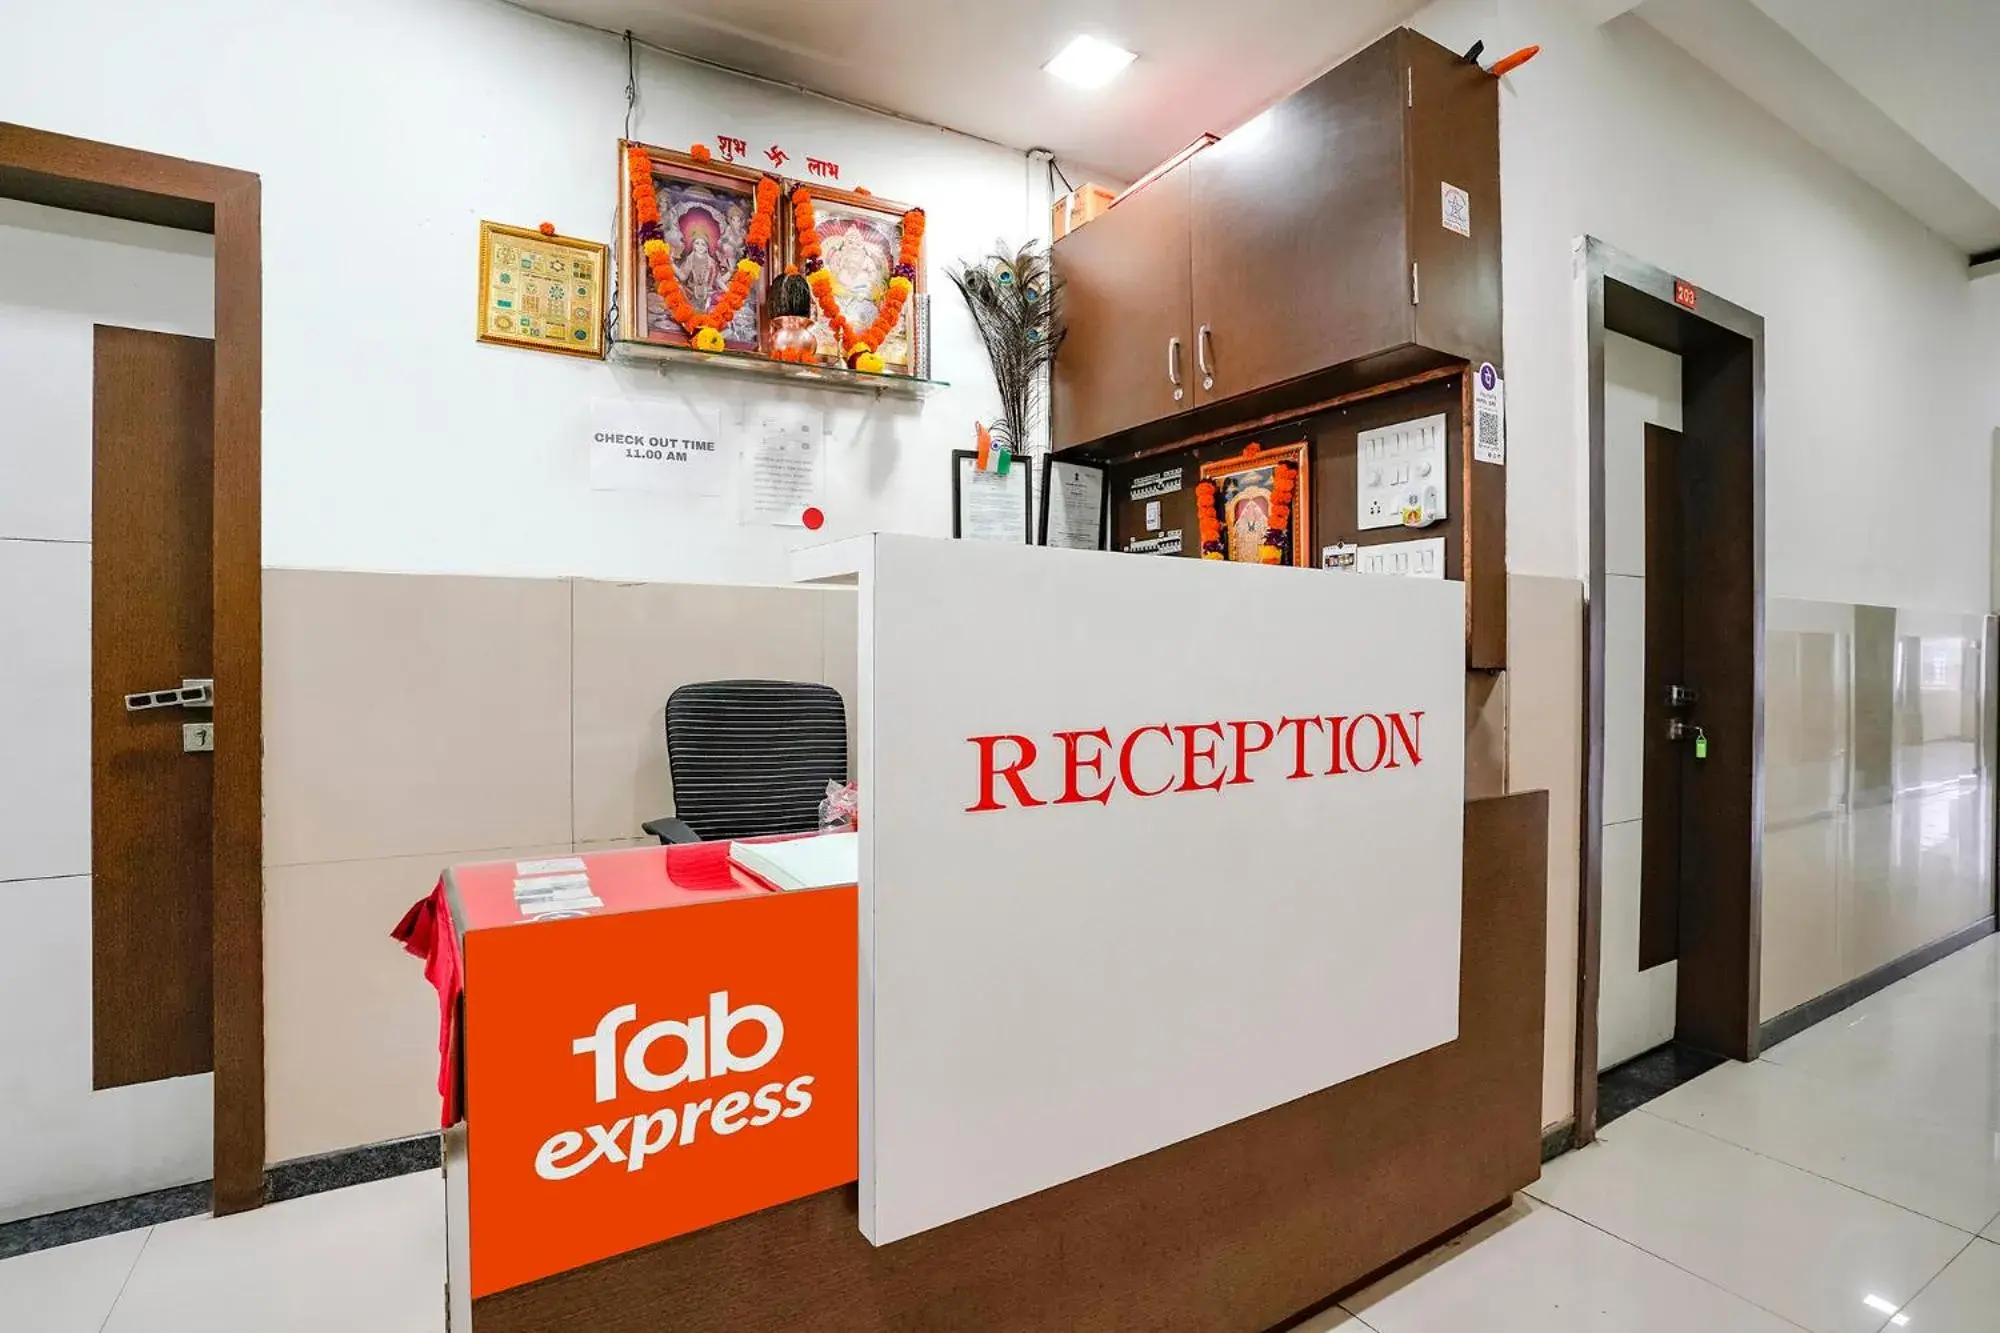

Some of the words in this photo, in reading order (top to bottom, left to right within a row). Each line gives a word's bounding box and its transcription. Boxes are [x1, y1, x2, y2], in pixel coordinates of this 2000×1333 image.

[717, 134, 746, 162] शुभ
[806, 157, 839, 179] लाभ
[1678, 286, 1695, 305] 203
[594, 432, 645, 446] CHECK
[648, 437, 678, 449] OUT
[682, 439, 715, 452] TIME
[626, 448, 662, 460] 11.00
[666, 451, 687, 462] AM
[965, 711, 1425, 812] RECEPTION
[572, 990, 784, 1103] fab
[534, 1074, 815, 1181] express
